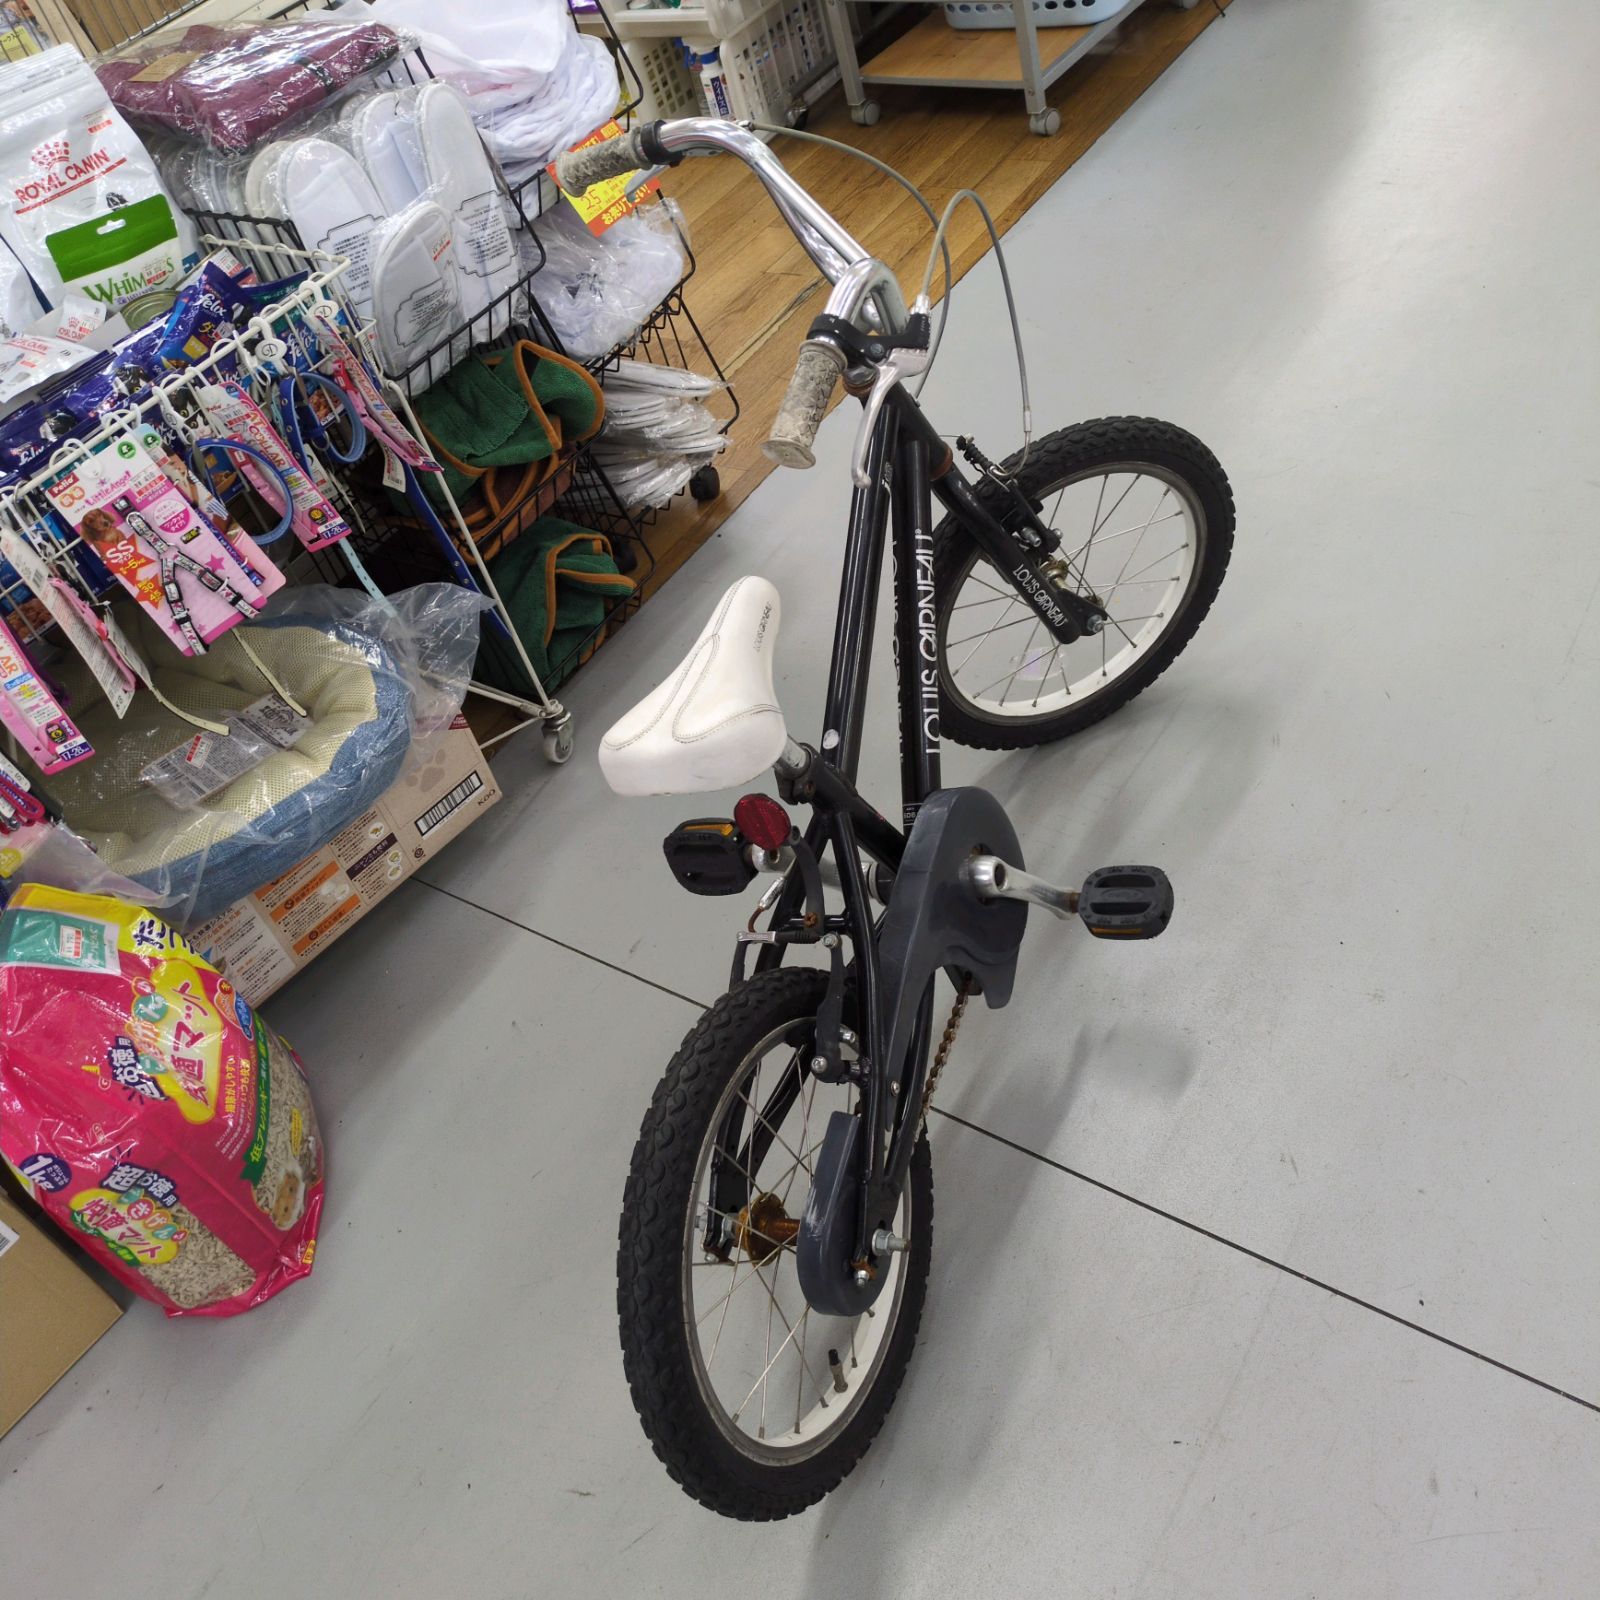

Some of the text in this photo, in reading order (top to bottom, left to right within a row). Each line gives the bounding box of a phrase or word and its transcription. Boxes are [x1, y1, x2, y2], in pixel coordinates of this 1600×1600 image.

[15, 149, 111, 205] ROYAL CANIN
[193, 293, 228, 317] felix
[52, 475, 75, 495] Petio
[106, 540, 134, 563] SS
[1013, 564, 1068, 627] LOUIS GARNEAU
[103, 1164, 177, 1207] 超お徳用
[79, 1197, 162, 1259] 快適マット
